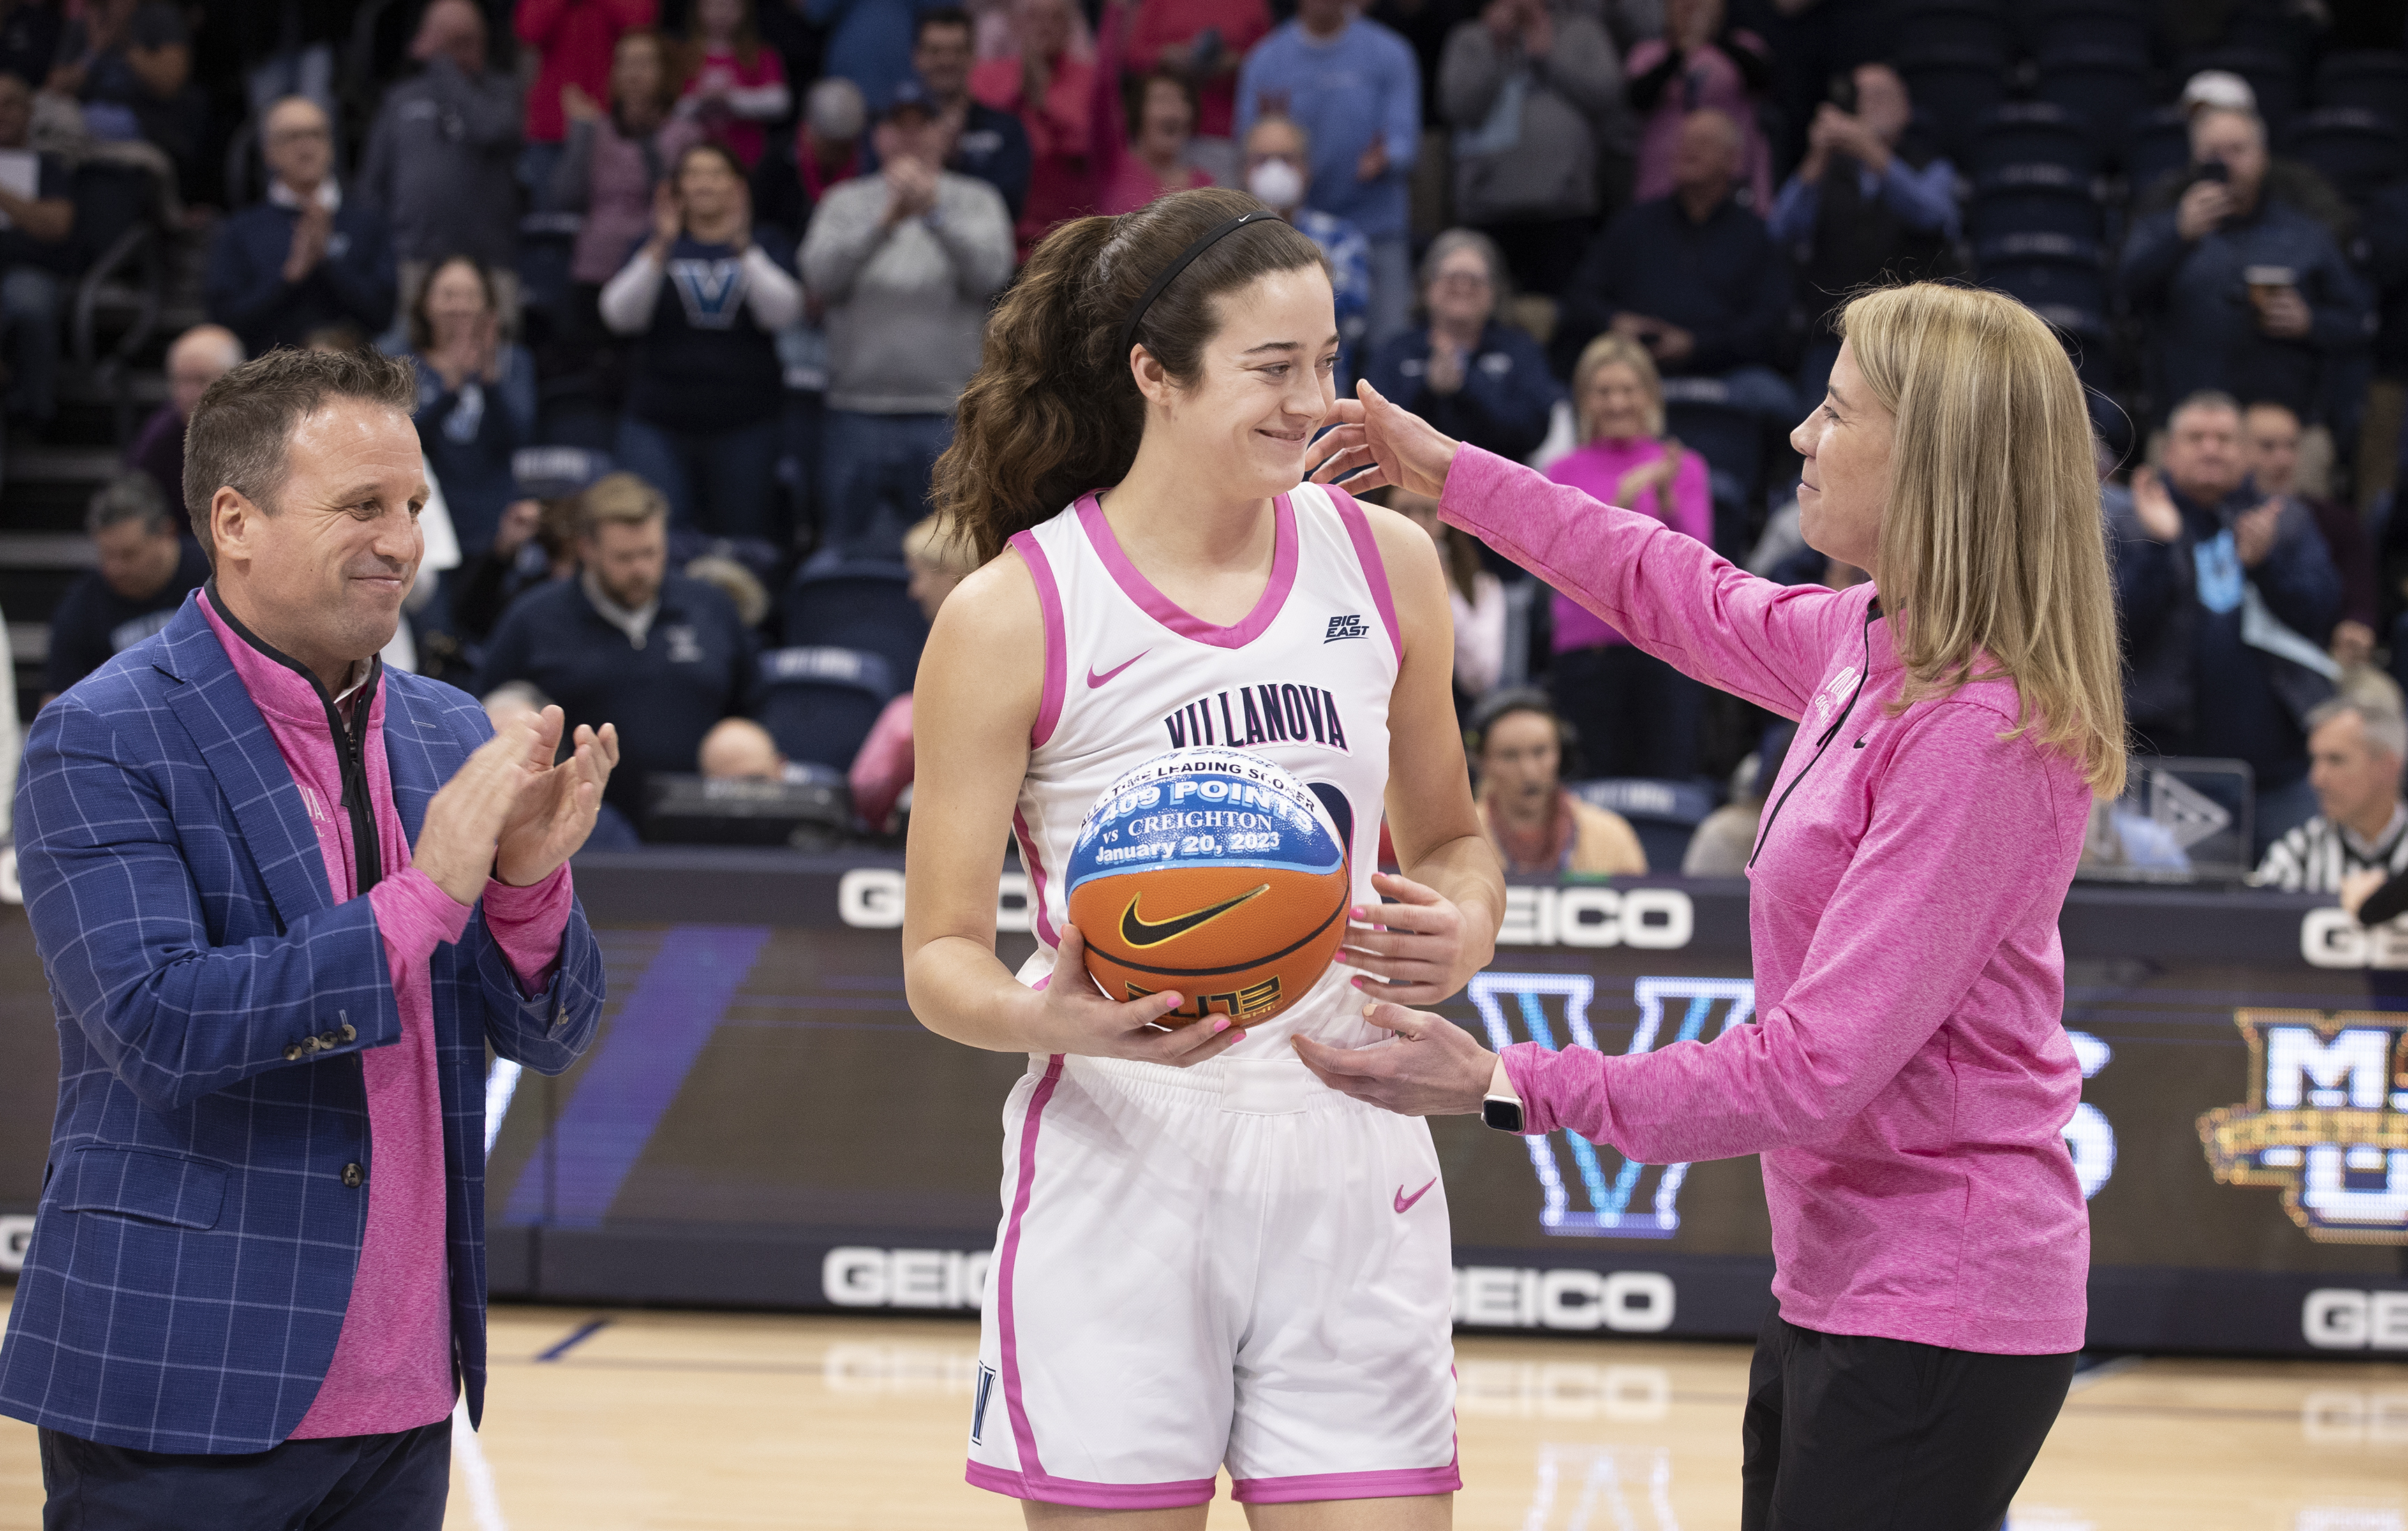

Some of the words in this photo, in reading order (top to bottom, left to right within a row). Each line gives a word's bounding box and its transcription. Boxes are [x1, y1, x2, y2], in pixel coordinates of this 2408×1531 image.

[1325, 626, 1369, 637] EAST
[1328, 614, 1361, 628] BIG
[1164, 683, 1350, 753] VILLANOVA
[1158, 762, 1242, 777] LEADING
[1127, 810, 1272, 837] CREIGHTON
[1173, 780, 1314, 832] POINTS
[1095, 841, 1176, 864] January
[1183, 834, 1223, 855] 20,
[1230, 831, 1281, 851] 2023
[1496, 885, 1695, 949] EICO
[822, 1245, 994, 1310] GEI
[1452, 1265, 1676, 1333] EICO
